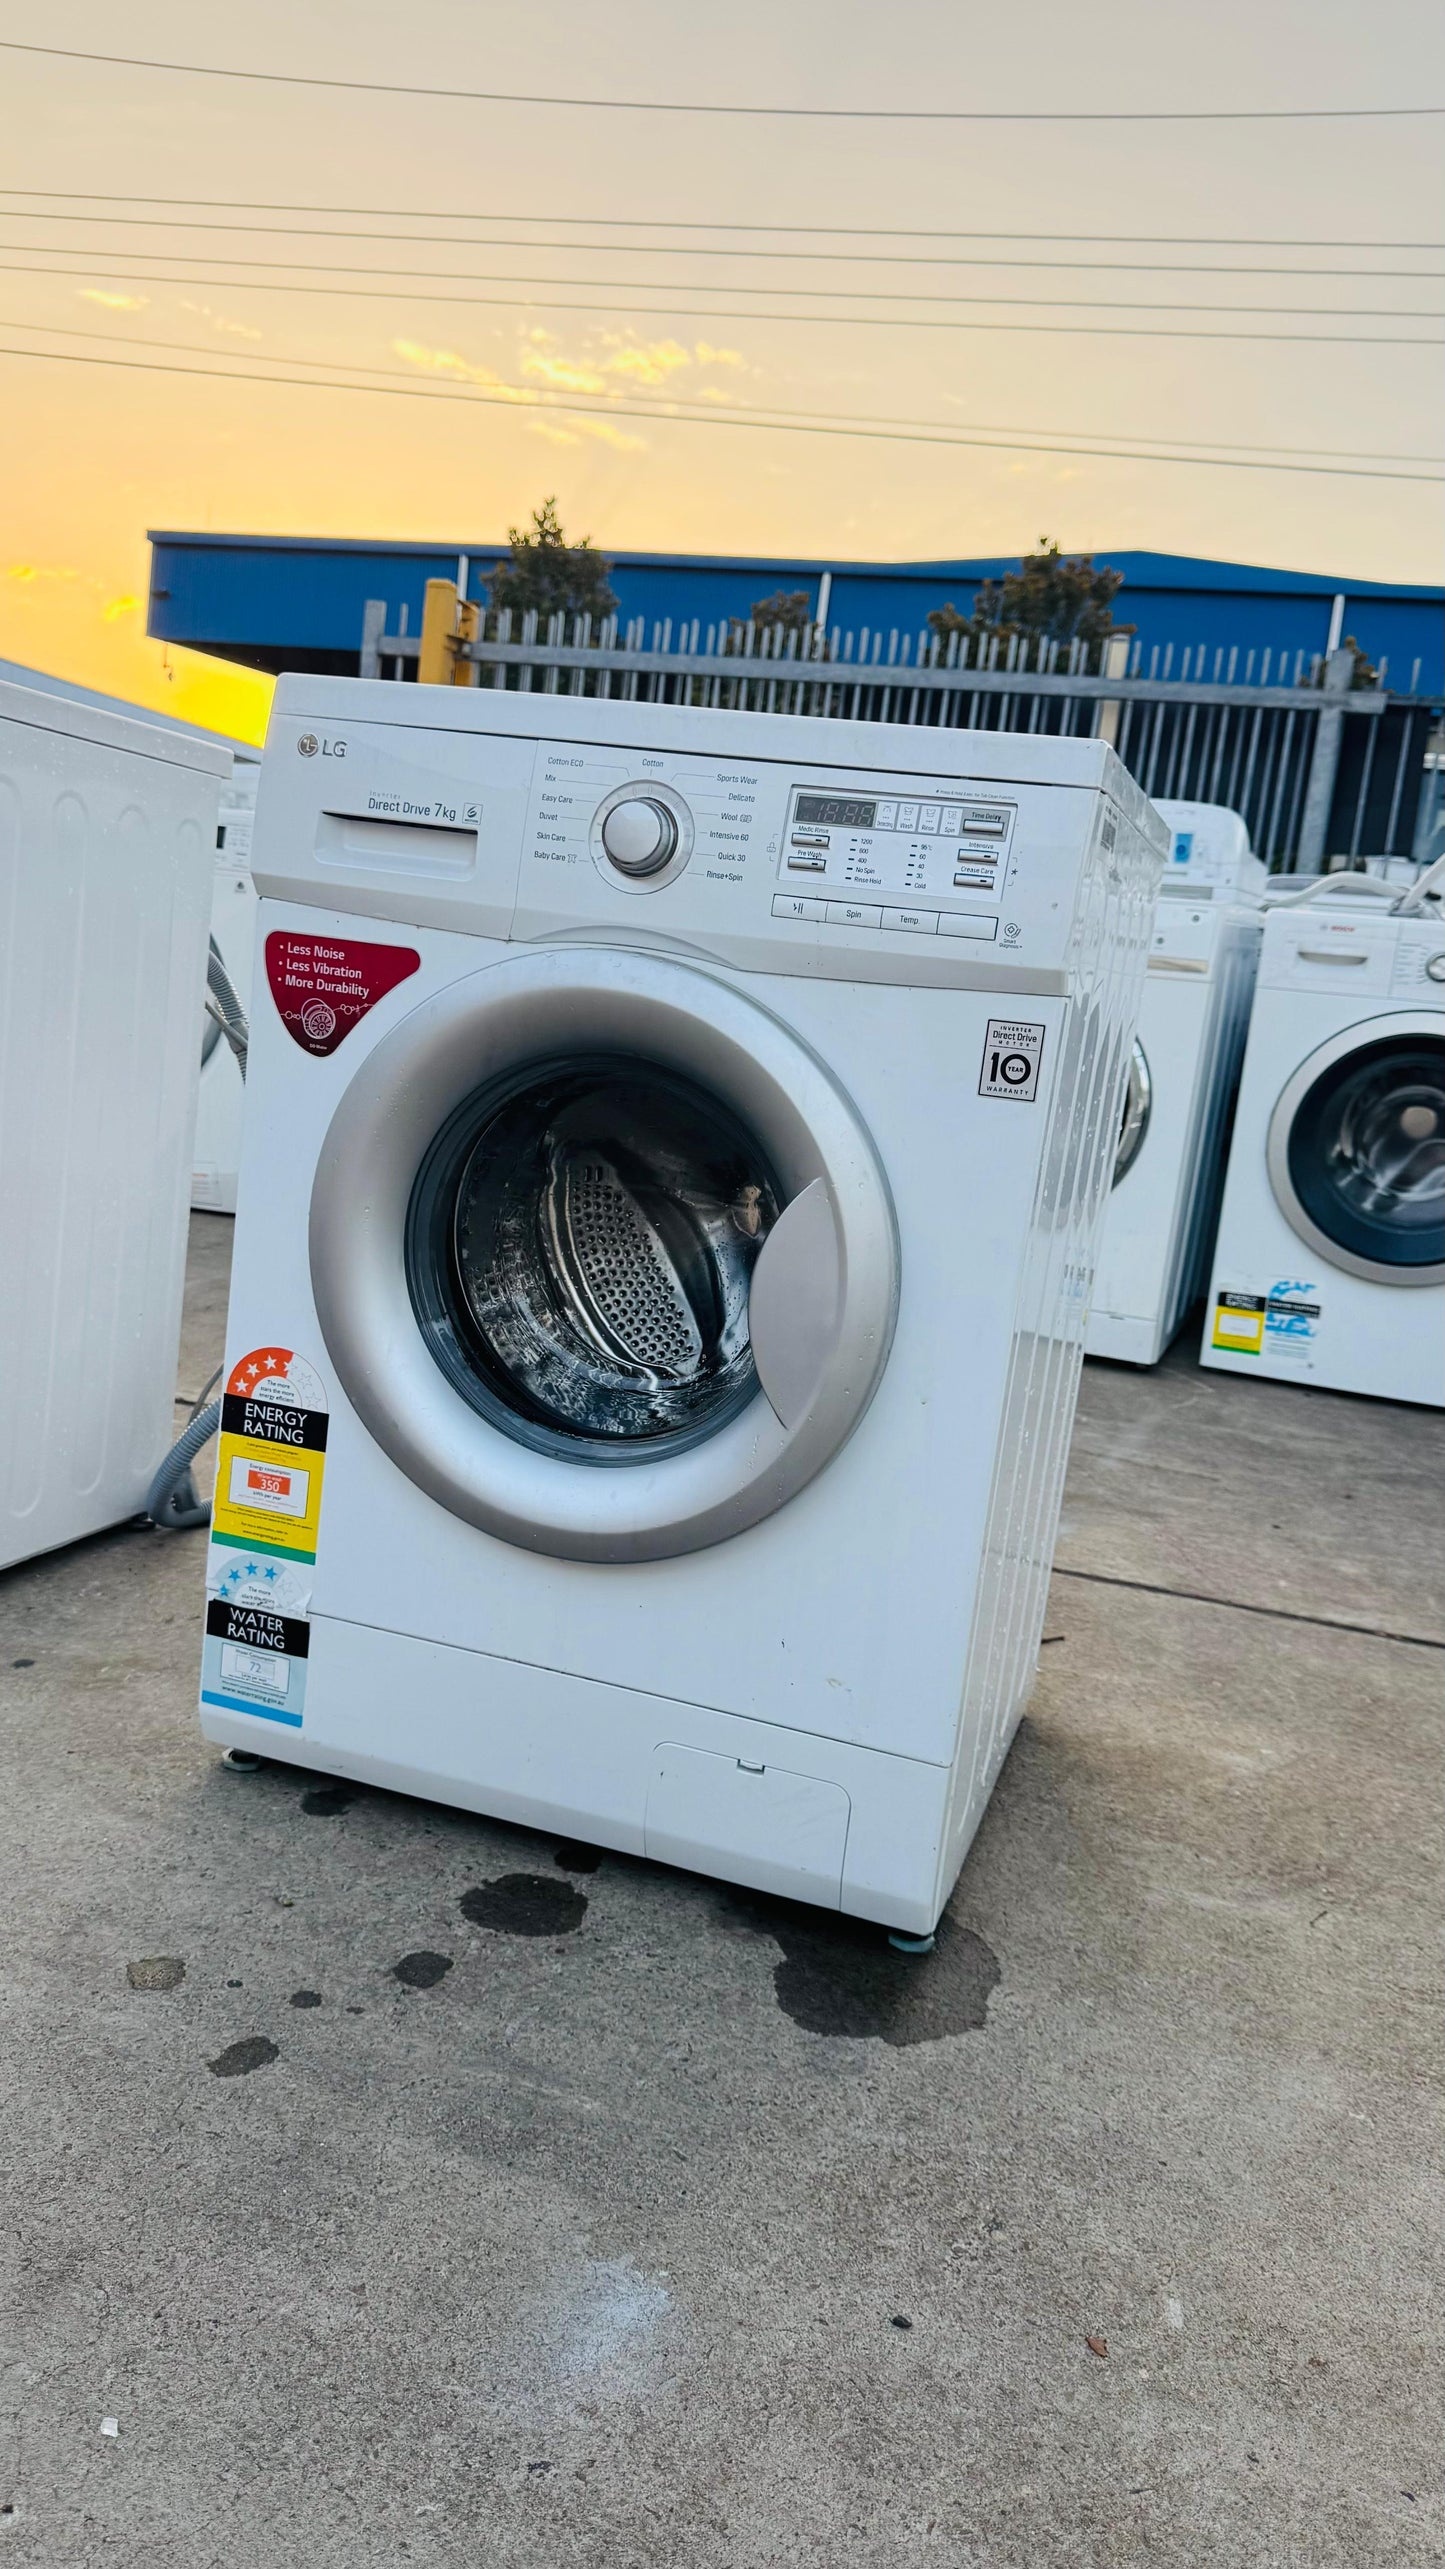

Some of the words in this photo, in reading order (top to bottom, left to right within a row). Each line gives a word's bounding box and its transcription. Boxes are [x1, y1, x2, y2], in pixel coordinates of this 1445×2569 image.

[322, 739, 347, 757] LG
[548, 756, 569, 767] Cotton
[571, 758, 583, 767] ECO
[642, 758, 664, 768] Cotton
[545, 774, 557, 782] Mix
[717, 774, 739, 784] Sports
[740, 776, 758, 785] Wear
[542, 794, 557, 804] Easy
[558, 795, 573, 804] Care
[728, 793, 755, 803] Delicate
[368, 798, 400, 813] Direct
[403, 802, 431, 816] Drive
[539, 812, 558, 821] Duvet
[721, 813, 738, 822] Wool
[986, 813, 1001, 821] Delay
[537, 832, 550, 841] Skin
[551, 834, 566, 842] Care
[709, 831, 739, 841] Intensive
[740, 833, 749, 842] 60
[534, 851, 550, 861] Baby
[551, 853, 566, 862] Care
[718, 852, 735, 862] Quick
[736, 853, 746, 862] 30
[864, 866, 875, 874] Spin
[961, 866, 980, 874] Crease
[706, 871, 743, 882] Rinse+Spin
[846, 910, 862, 919] Spin
[288, 942, 311, 956] Less
[314, 945, 345, 960] Noise
[286, 958, 310, 972] Less
[313, 962, 362, 979] Vibration
[285, 974, 314, 989] More
[316, 979, 370, 1000] Durability
[993, 1031, 1016, 1040] Direct
[1017, 1033, 1037, 1042] Drive
[990, 1052, 1031, 1085] 10
[986, 1086, 1029, 1095] WARRANTY
[245, 1402, 307, 1427] ENERGY
[244, 1420, 304, 1444] RATING
[260, 1479, 280, 1492] 350
[230, 1607, 284, 1633] WATER
[227, 1622, 285, 1649] RATING
[249, 1661, 262, 1673] 72
